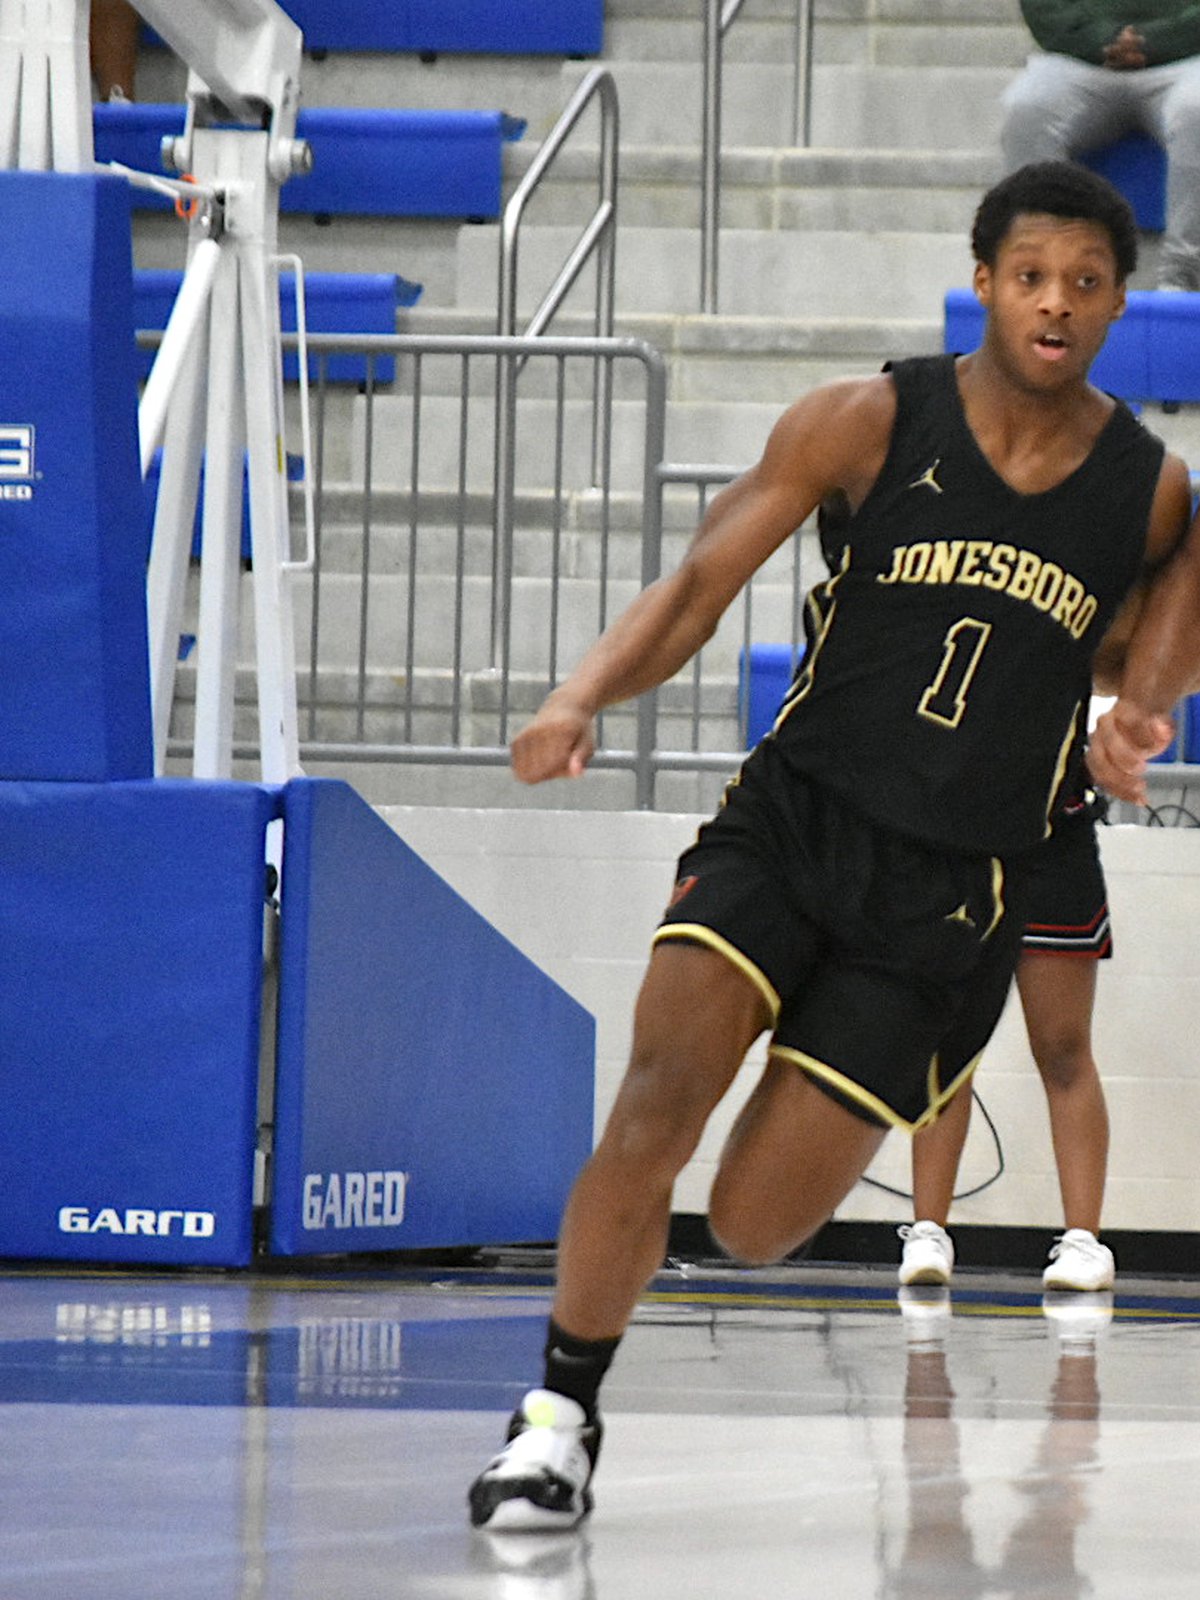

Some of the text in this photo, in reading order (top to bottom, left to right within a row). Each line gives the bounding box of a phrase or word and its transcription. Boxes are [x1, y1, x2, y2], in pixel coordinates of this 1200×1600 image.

[876, 540, 1099, 640] JONESBORO
[917, 616, 993, 729] 1
[302, 1171, 406, 1230] GARED
